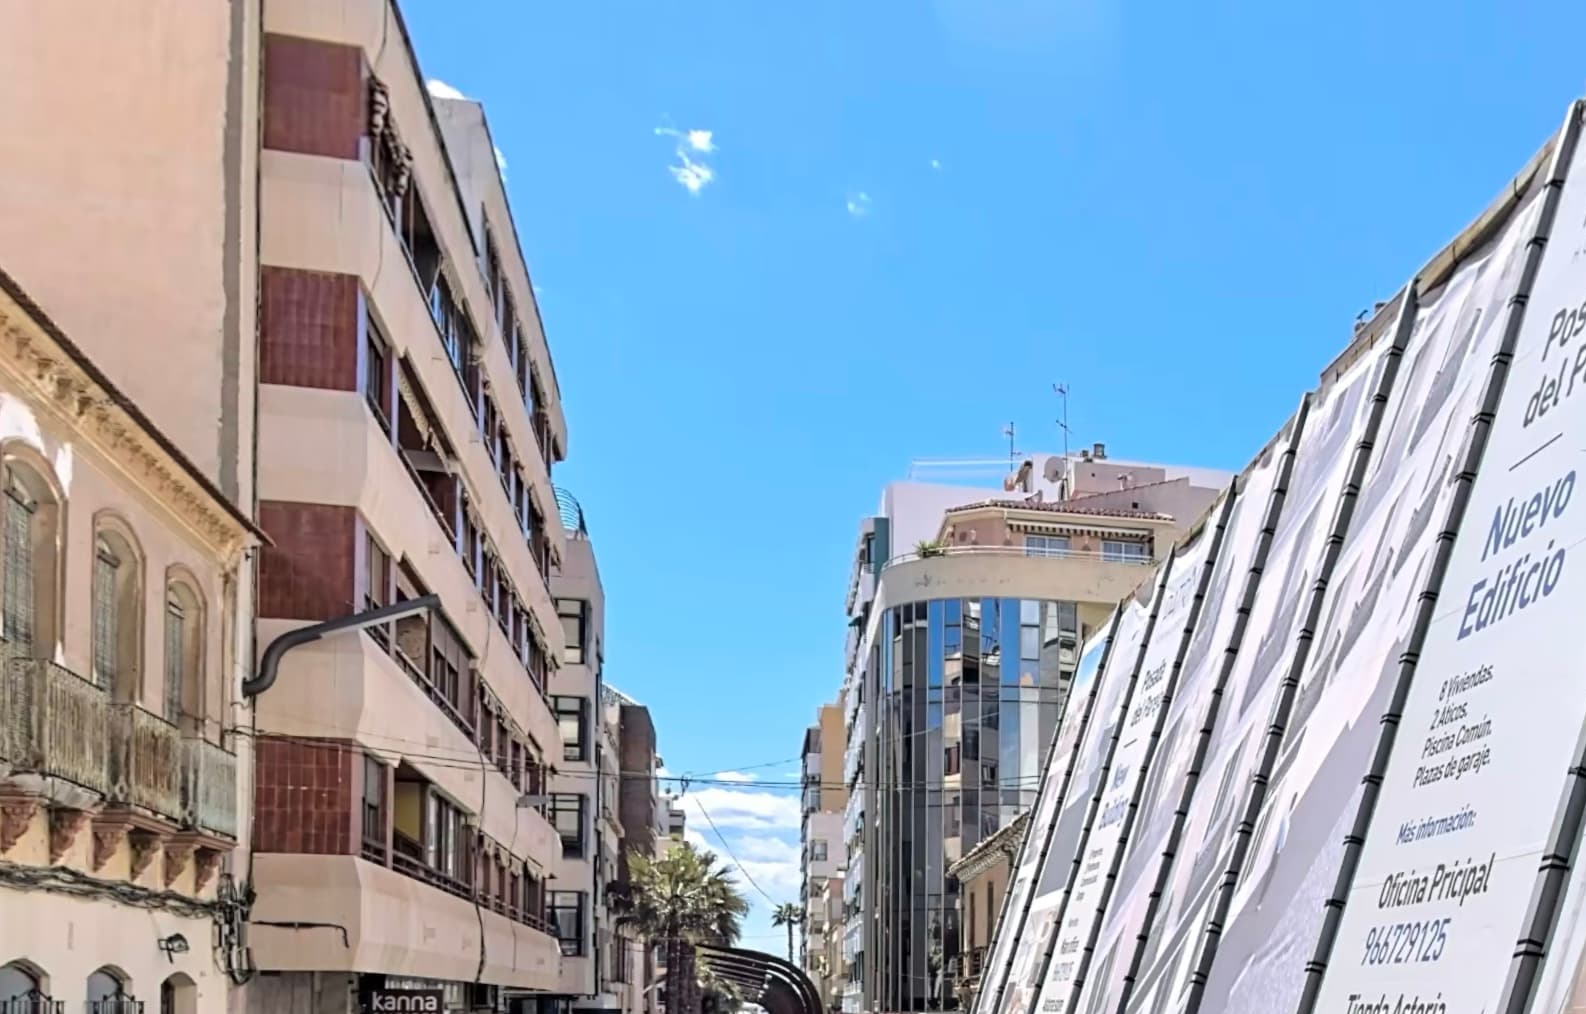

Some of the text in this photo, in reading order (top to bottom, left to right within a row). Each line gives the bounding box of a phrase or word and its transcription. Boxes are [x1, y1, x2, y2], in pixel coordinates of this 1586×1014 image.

[1523, 357, 1568, 428] del
[1480, 469, 1577, 563] Nuevo
[1456, 538, 1566, 642] Edificio
[1429, 708, 1440, 731] 2
[1420, 731, 1456, 760] Piscina
[1412, 764, 1446, 789] Plazas
[1443, 755, 1458, 779] de
[1395, 802, 1478, 846] Más información:
[1377, 851, 1496, 910] Oficina Pricipal
[1360, 917, 1452, 967] 966729125
[371, 991, 438, 1011] kanna
